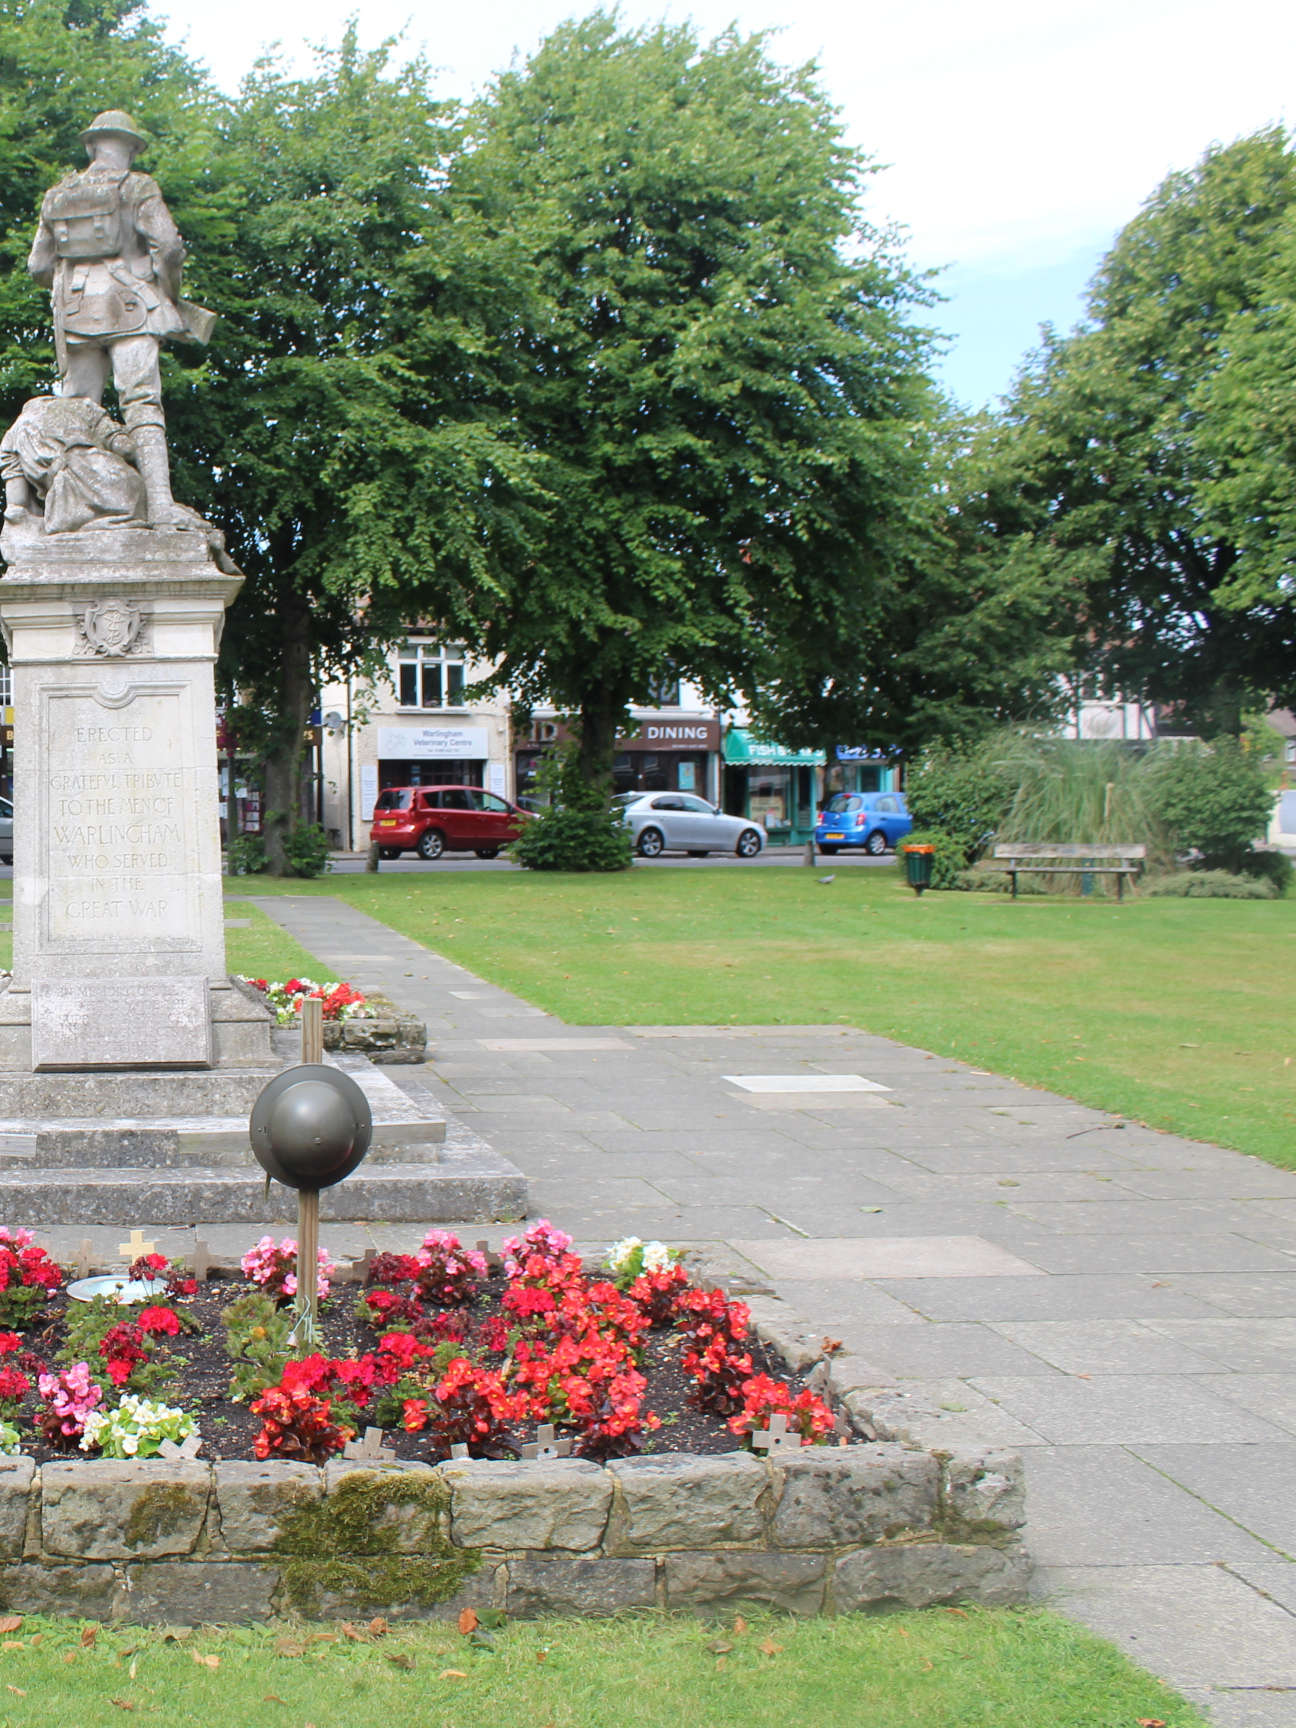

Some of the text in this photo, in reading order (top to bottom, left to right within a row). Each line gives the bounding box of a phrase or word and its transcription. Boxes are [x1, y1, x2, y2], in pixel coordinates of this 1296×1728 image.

[76, 727, 153, 742] ERECTED
[422, 730, 463, 739] Warlingham
[647, 726, 708, 740] DINING
[412, 739, 448, 748] Veterinary
[748, 745, 776, 756] FISH
[59, 797, 174, 816] TO THE MEN OF
[54, 823, 181, 845] WARLINGHAM
[68, 853, 169, 869] WHO SERVED
[66, 900, 168, 919] GREAT WAR
